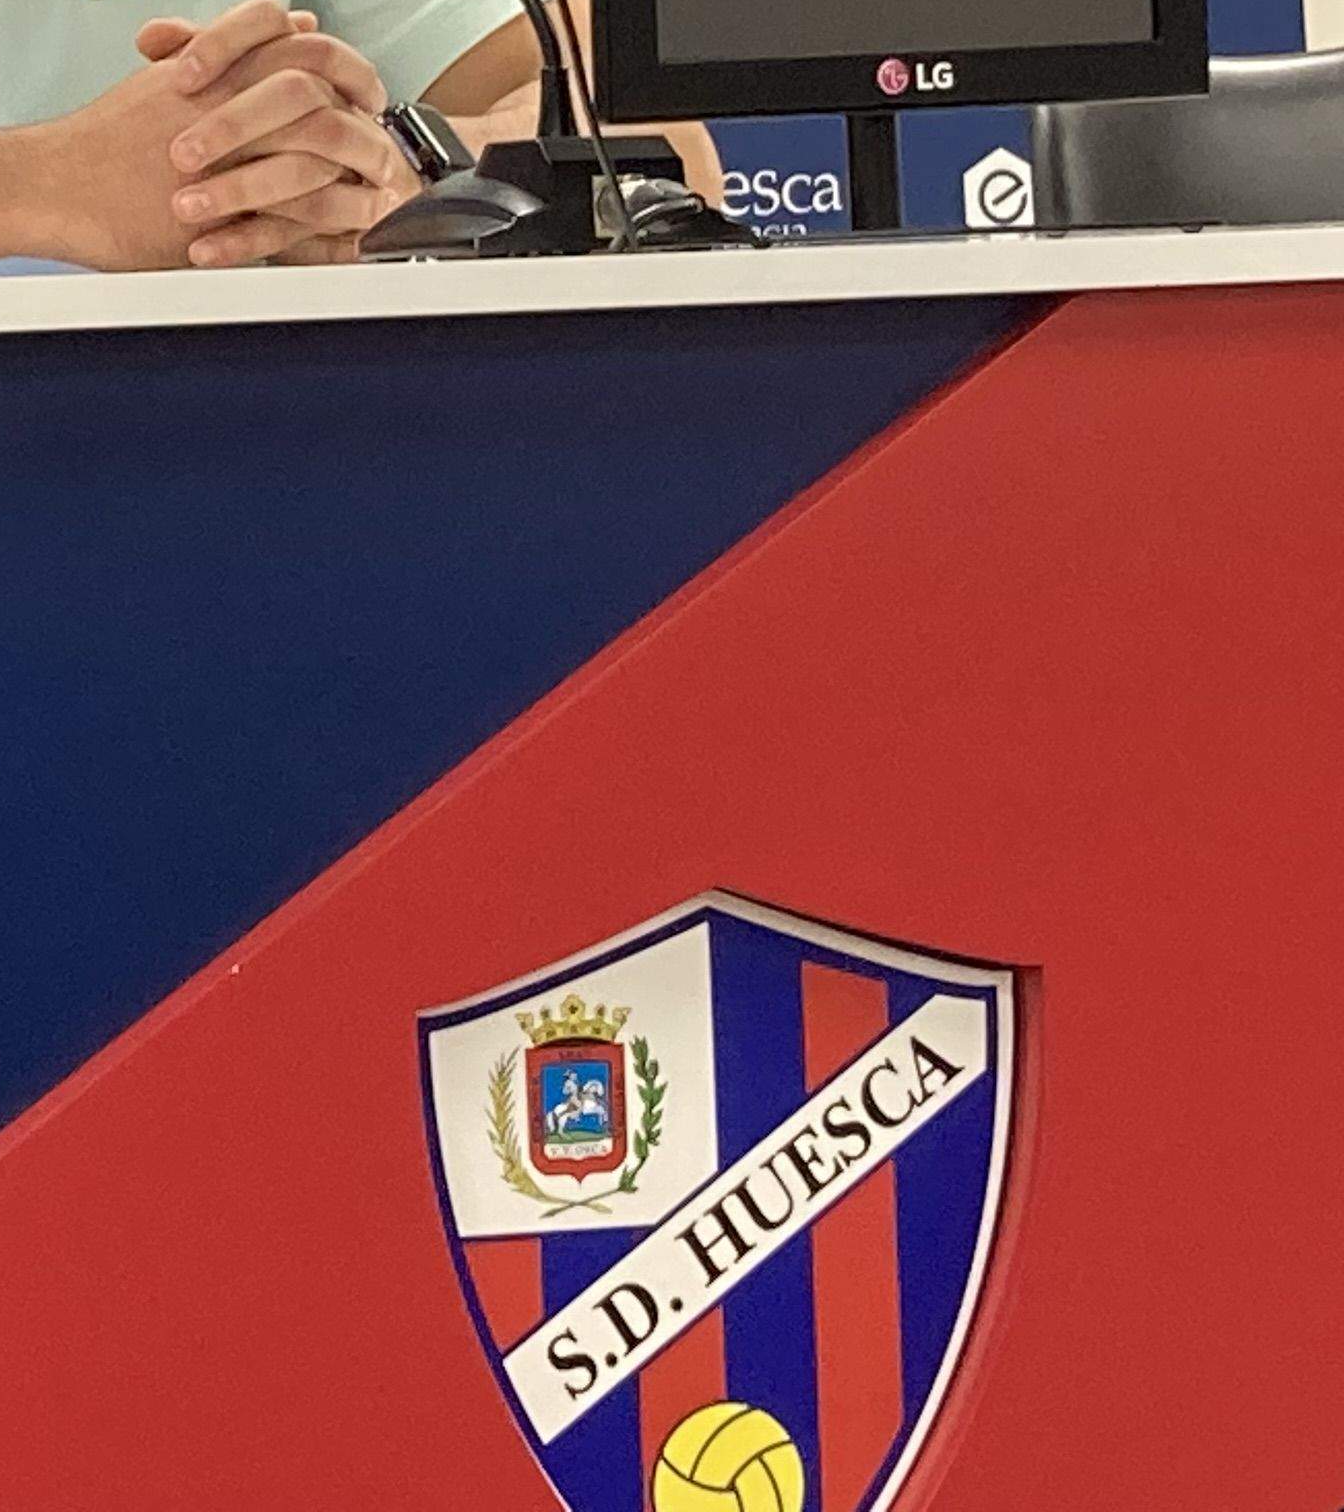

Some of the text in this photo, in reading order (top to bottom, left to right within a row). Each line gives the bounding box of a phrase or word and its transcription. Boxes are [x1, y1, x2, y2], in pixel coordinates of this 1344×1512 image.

[915, 61, 954, 91] LG
[720, 167, 843, 217] esca
[546, 1034, 966, 1398] S.D. HUESCA
